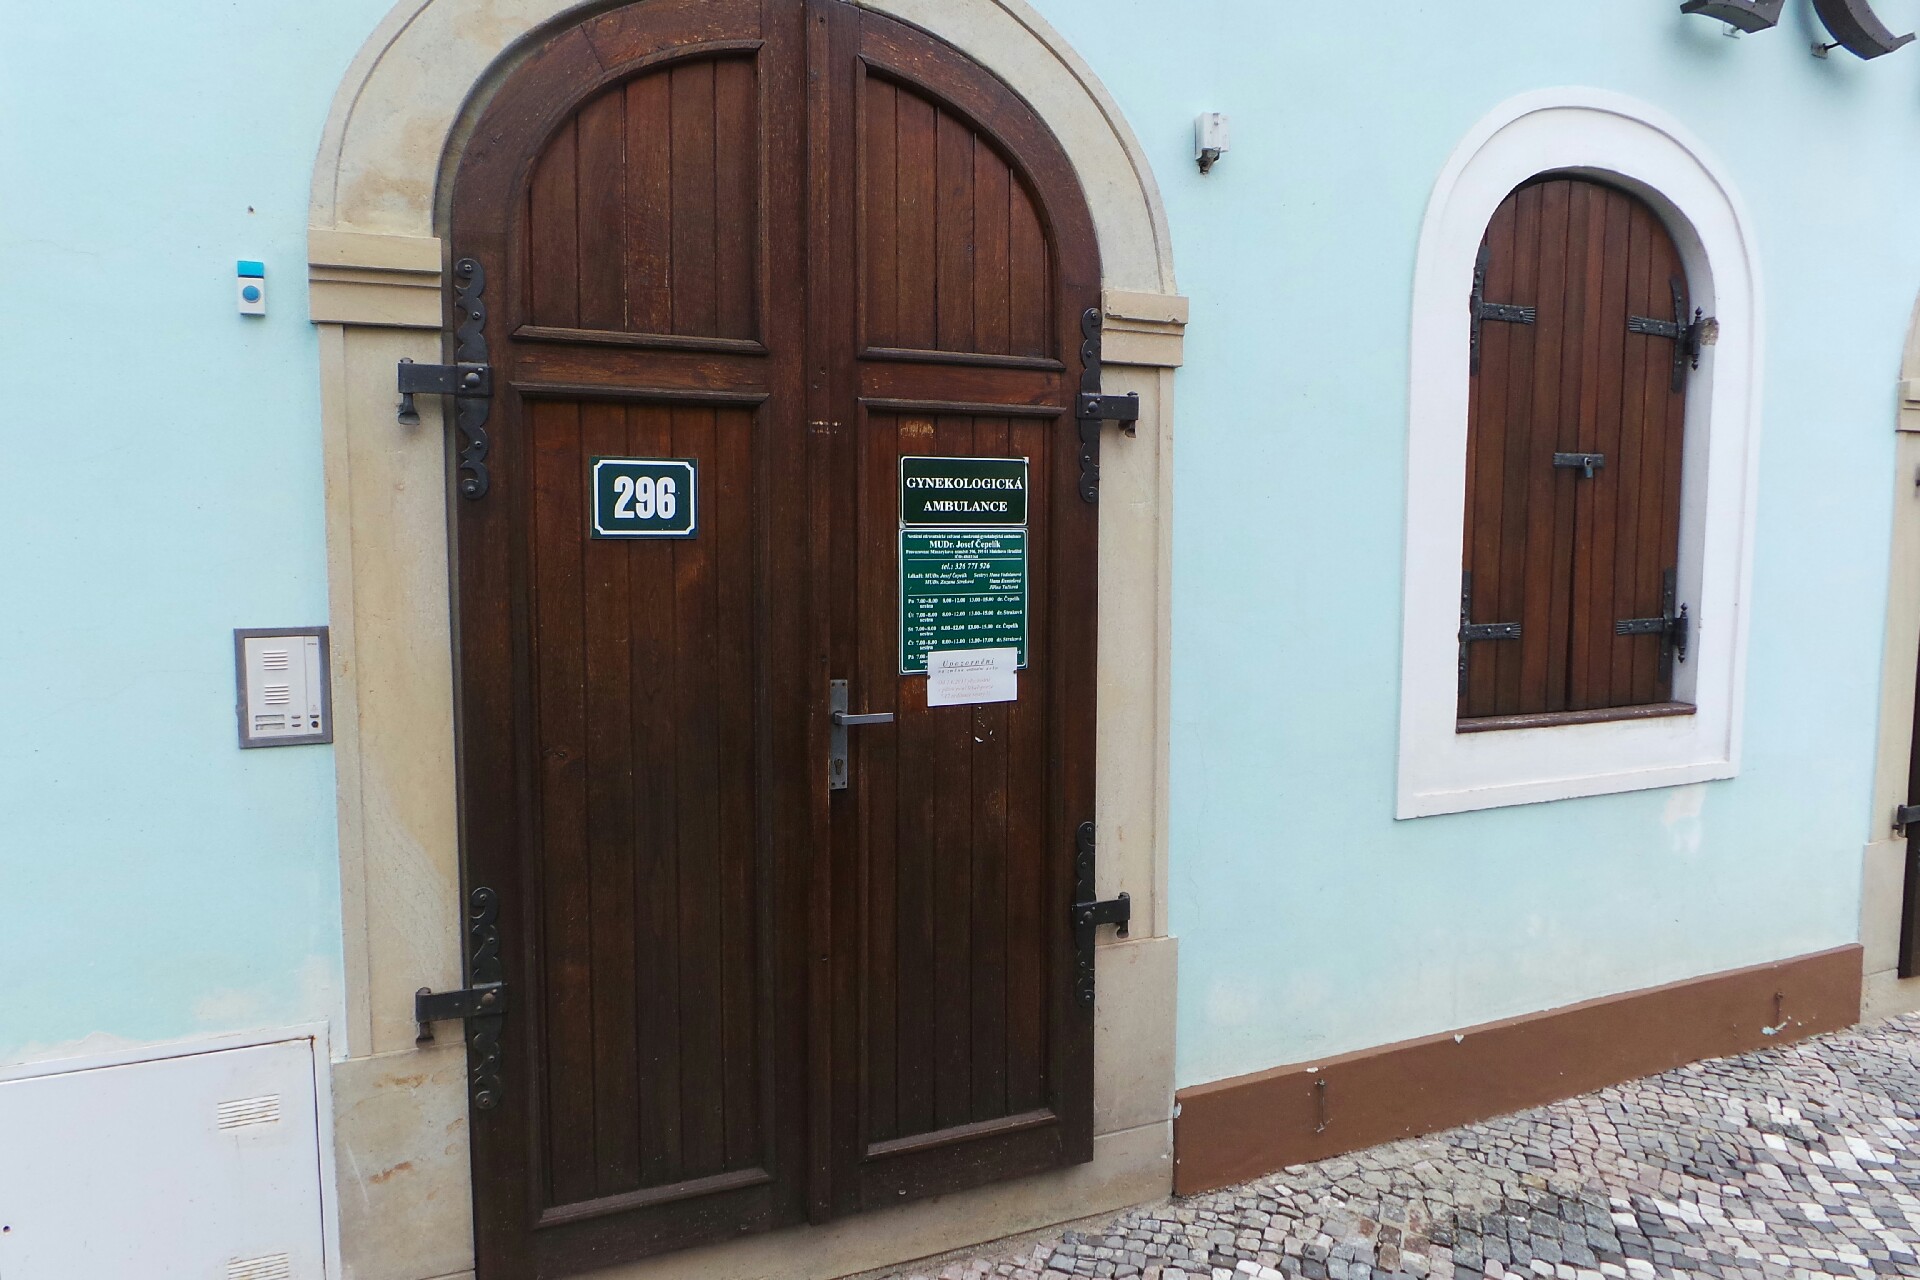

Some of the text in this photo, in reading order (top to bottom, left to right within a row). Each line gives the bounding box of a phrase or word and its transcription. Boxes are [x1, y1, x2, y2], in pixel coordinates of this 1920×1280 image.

[907, 477, 1023, 489] GYNEKOLOGICKÁ
[614, 476, 676, 519] 296
[923, 501, 1008, 512] AMBULANCE
[929, 540, 955, 549] MUDr.
[956, 540, 975, 549] Josef
